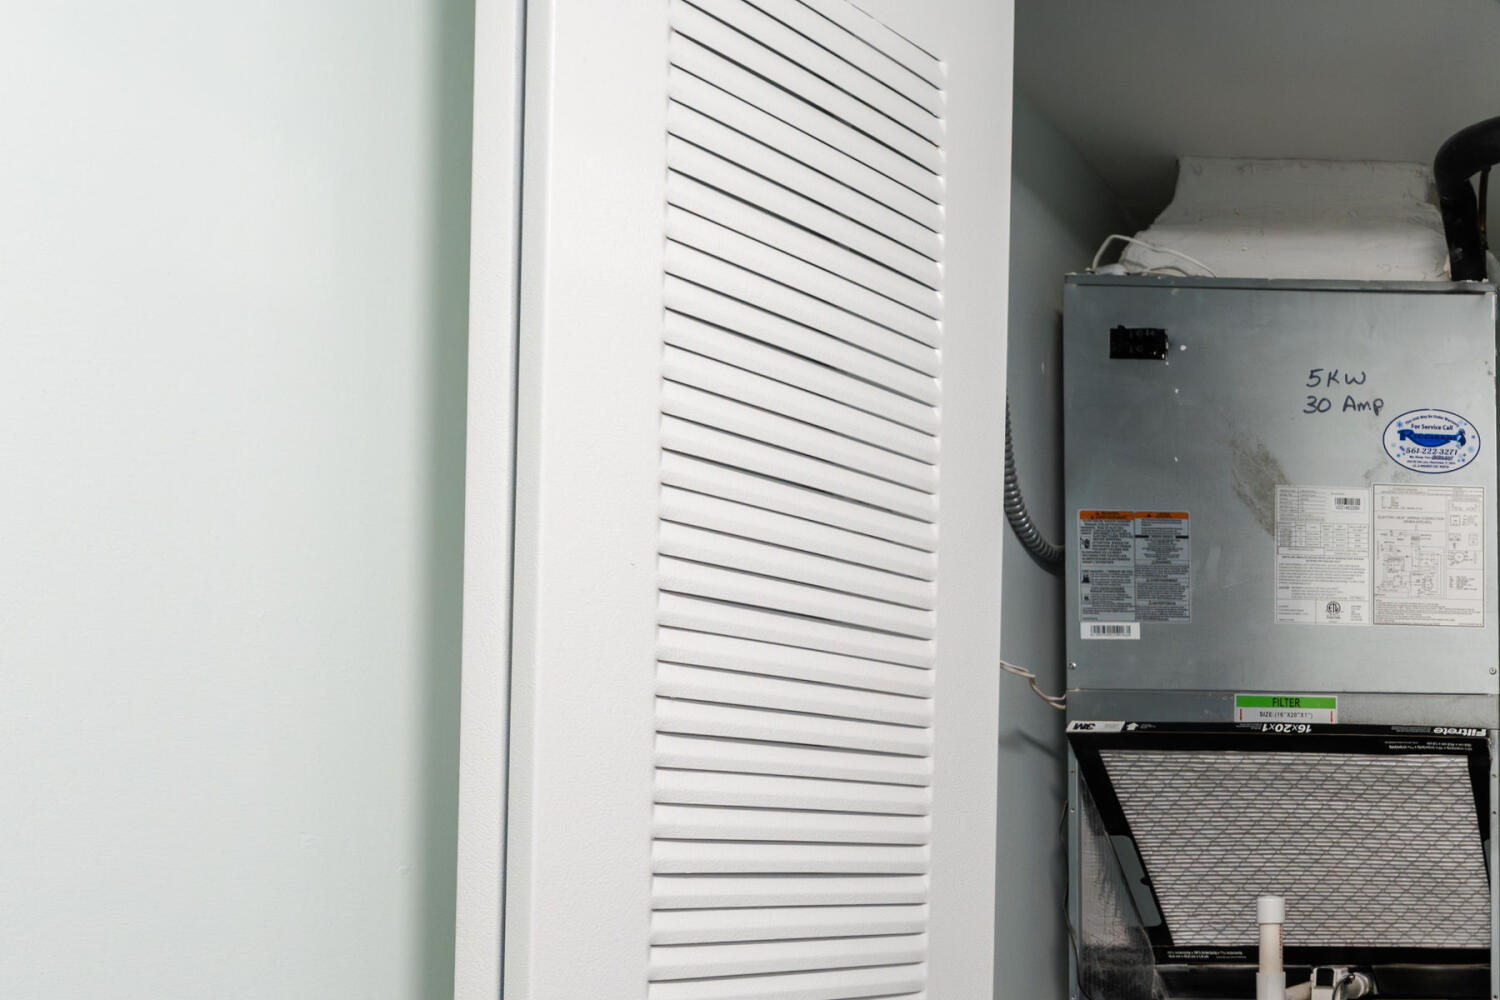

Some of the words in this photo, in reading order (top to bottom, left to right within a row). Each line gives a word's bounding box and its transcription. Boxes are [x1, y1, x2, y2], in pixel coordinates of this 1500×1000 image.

[1303, 395, 1332, 414] 30
[1342, 395, 1384, 416] Amp
[1272, 697, 1300, 708] FILTER
[1262, 723, 1312, 733] 16x20x1
[1434, 728, 1487, 737] Filtrete
